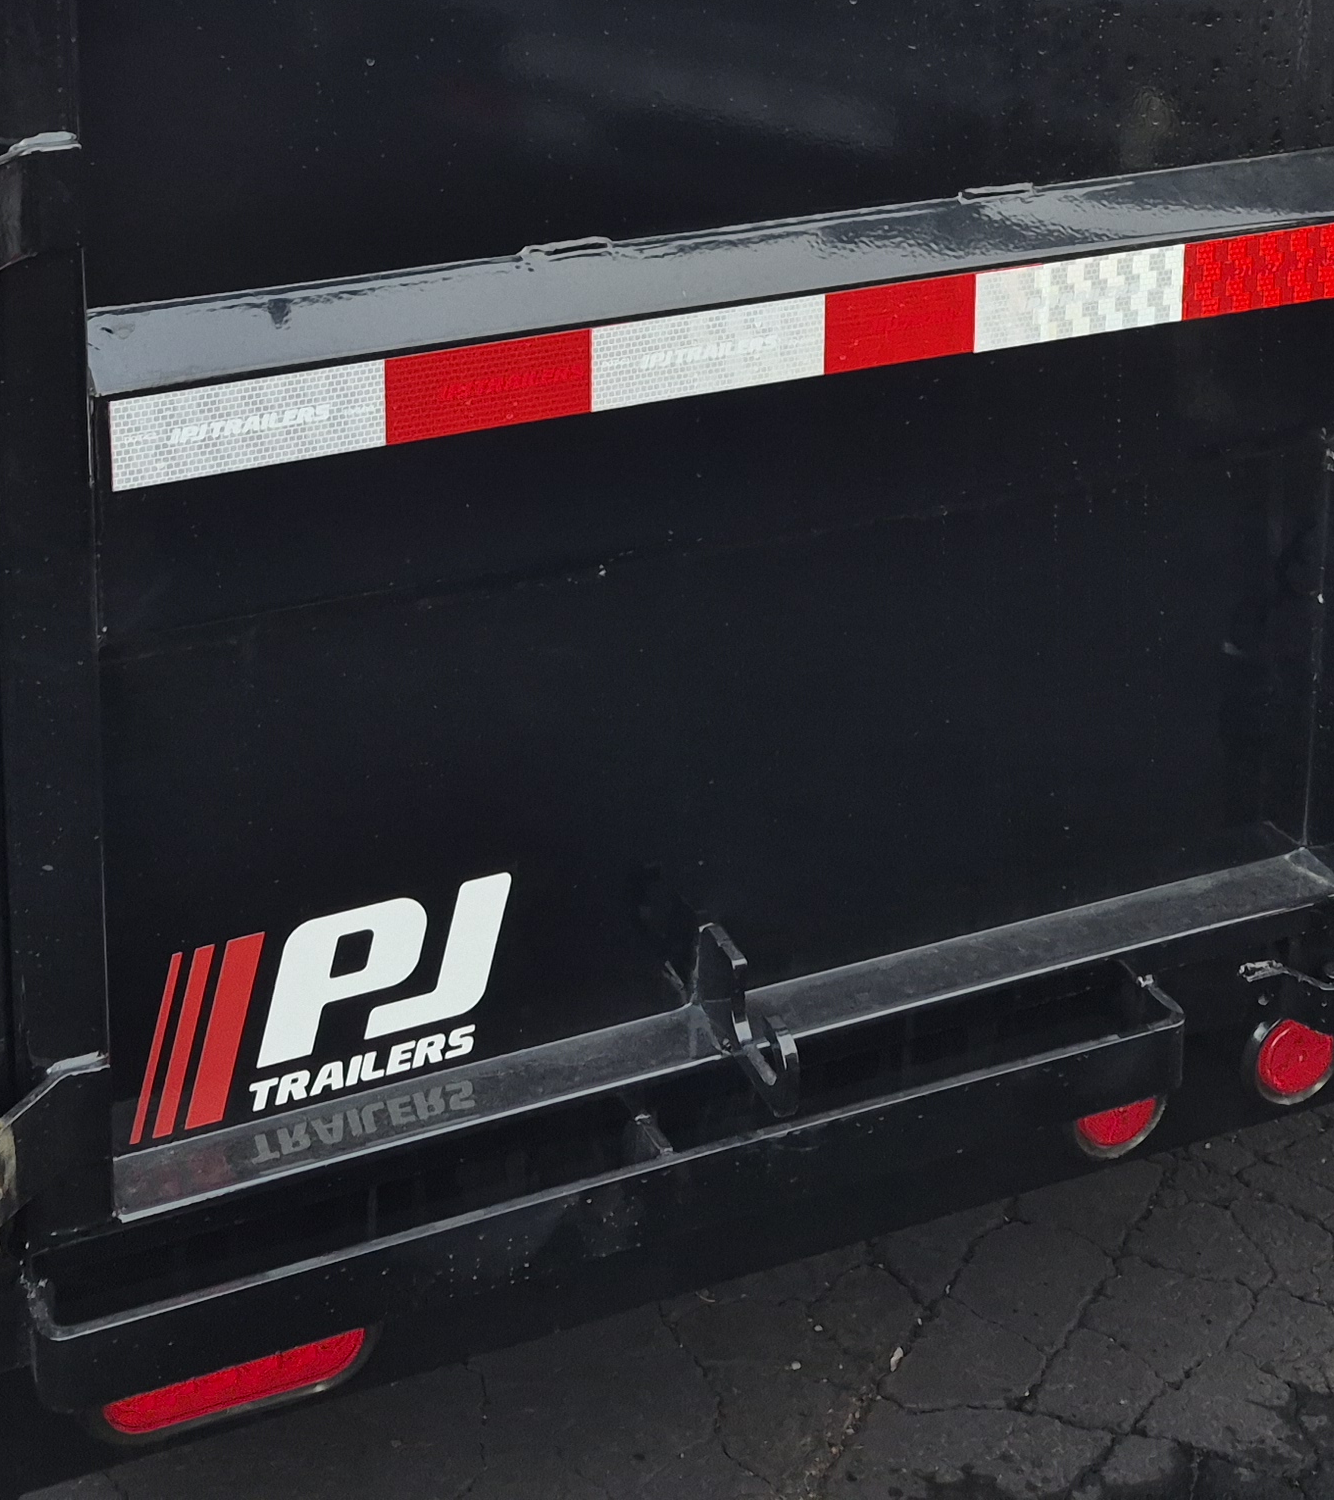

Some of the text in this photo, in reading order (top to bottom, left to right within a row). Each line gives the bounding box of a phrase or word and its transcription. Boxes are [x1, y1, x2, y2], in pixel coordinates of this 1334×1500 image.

[208, 403, 331, 439] TRAILERS
[256, 871, 512, 1069] PJ
[248, 1023, 476, 1112] TRAILERS
